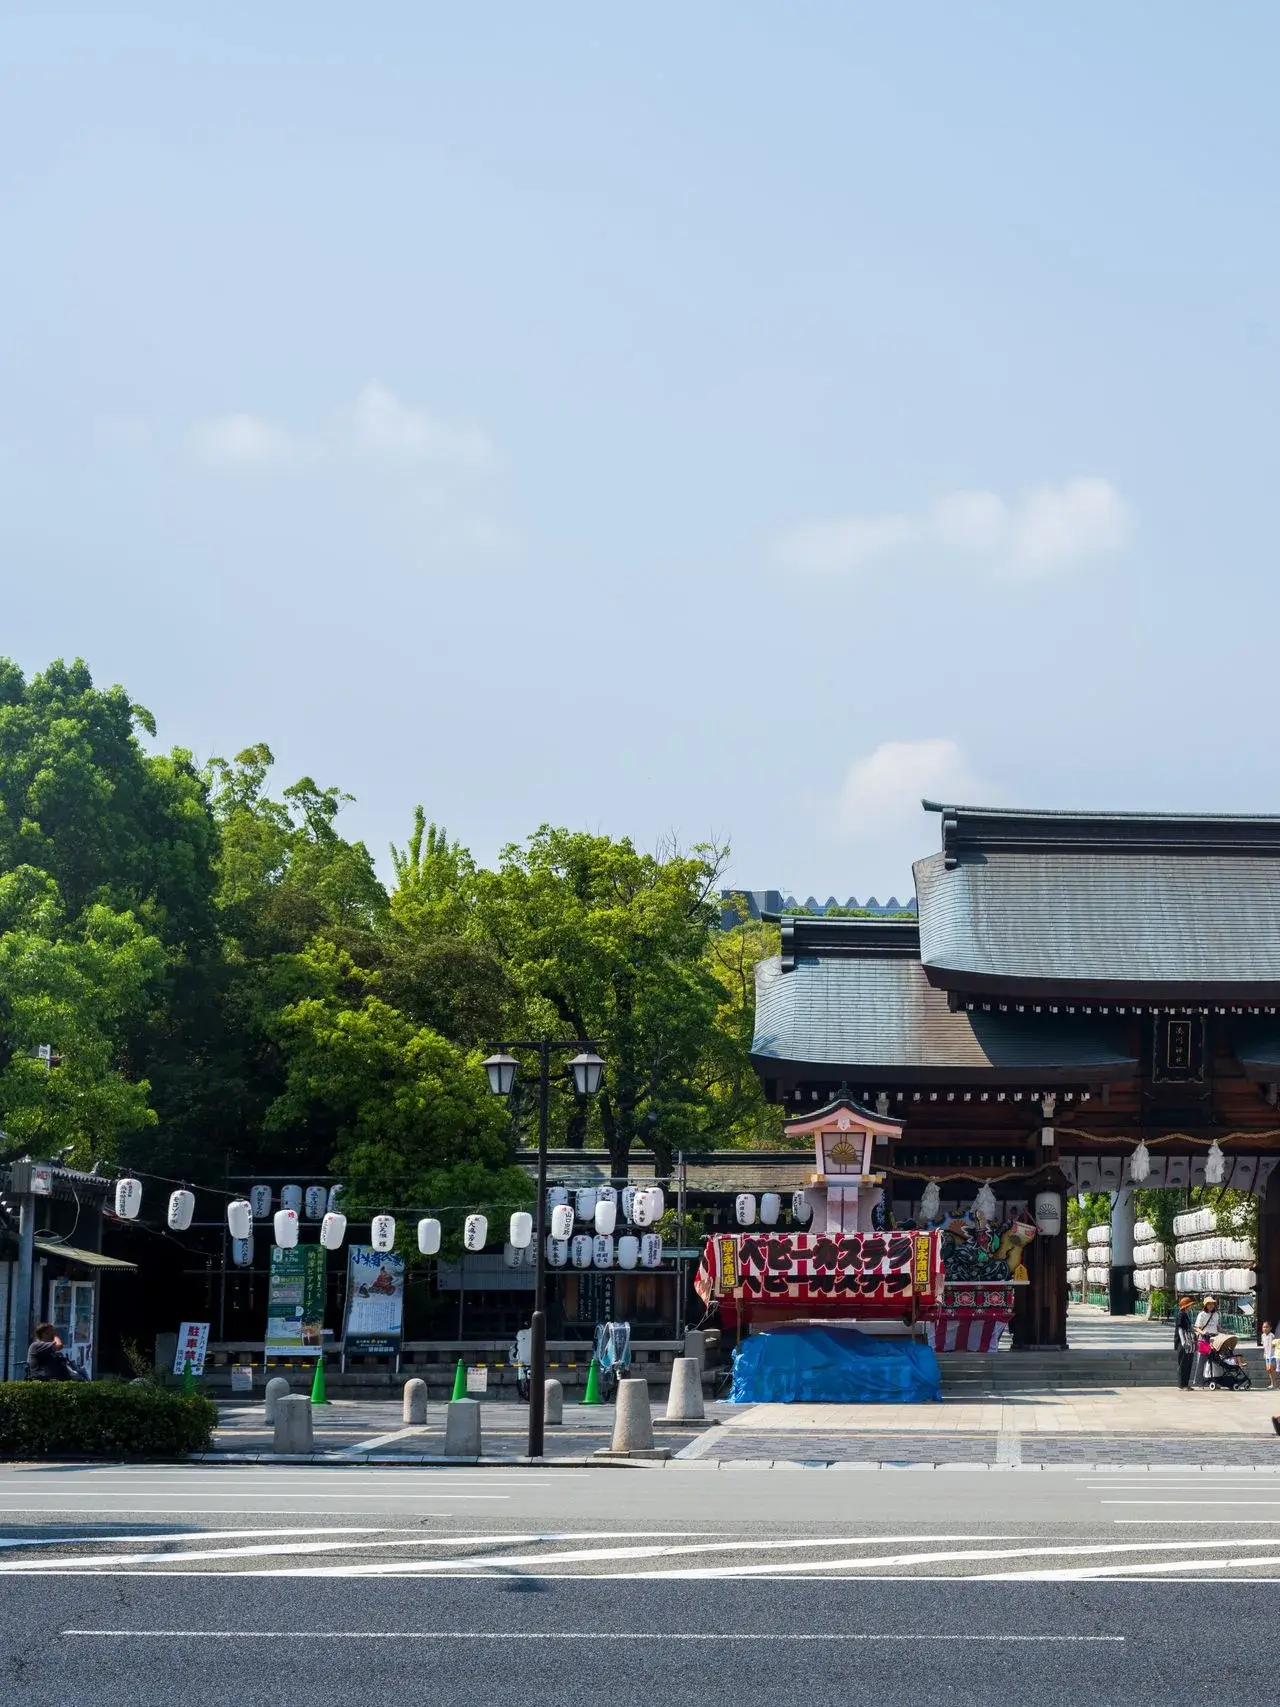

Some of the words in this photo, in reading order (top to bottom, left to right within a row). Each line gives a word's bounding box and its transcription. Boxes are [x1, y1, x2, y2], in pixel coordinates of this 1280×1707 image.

[738, 1236, 913, 1272] ベビーカステラ
